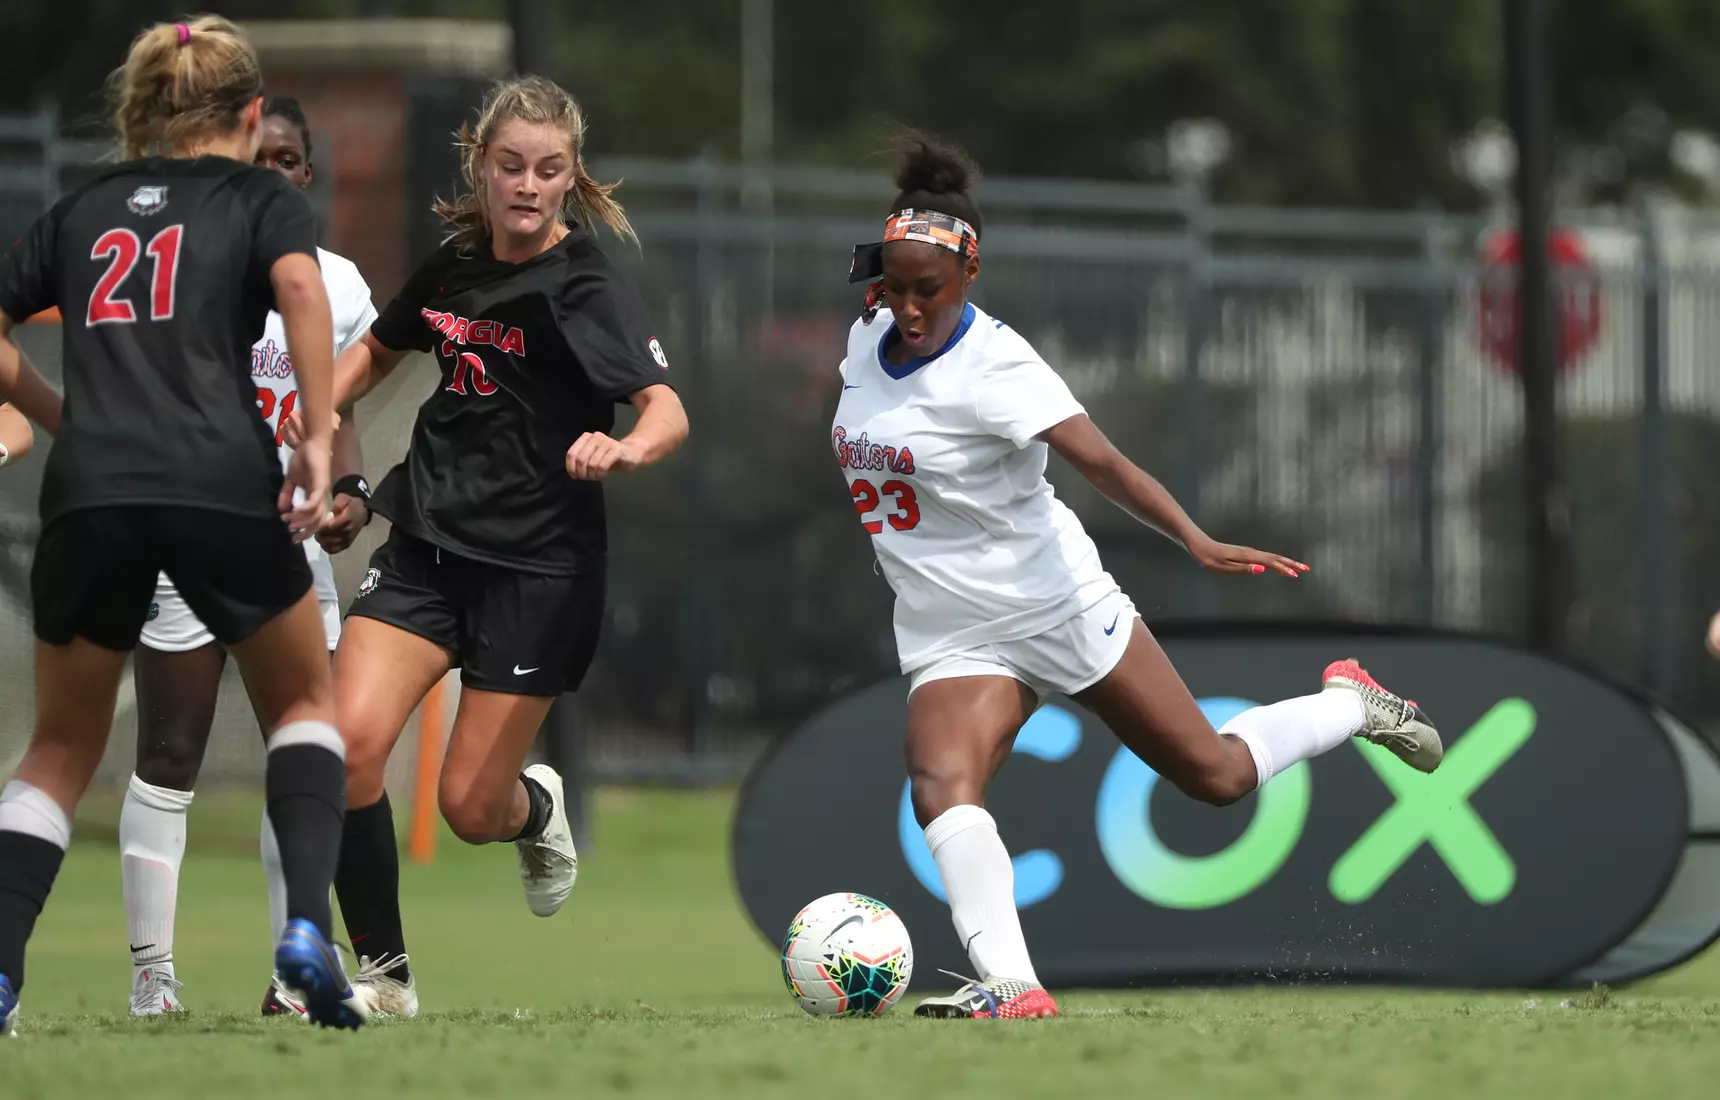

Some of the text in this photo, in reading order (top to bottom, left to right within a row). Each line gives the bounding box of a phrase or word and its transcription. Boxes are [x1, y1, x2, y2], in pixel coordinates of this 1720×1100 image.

[86, 224, 184, 328] 21
[421, 307, 525, 357] ORGIA
[831, 425, 915, 475] Gators
[850, 478, 921, 535] 23
